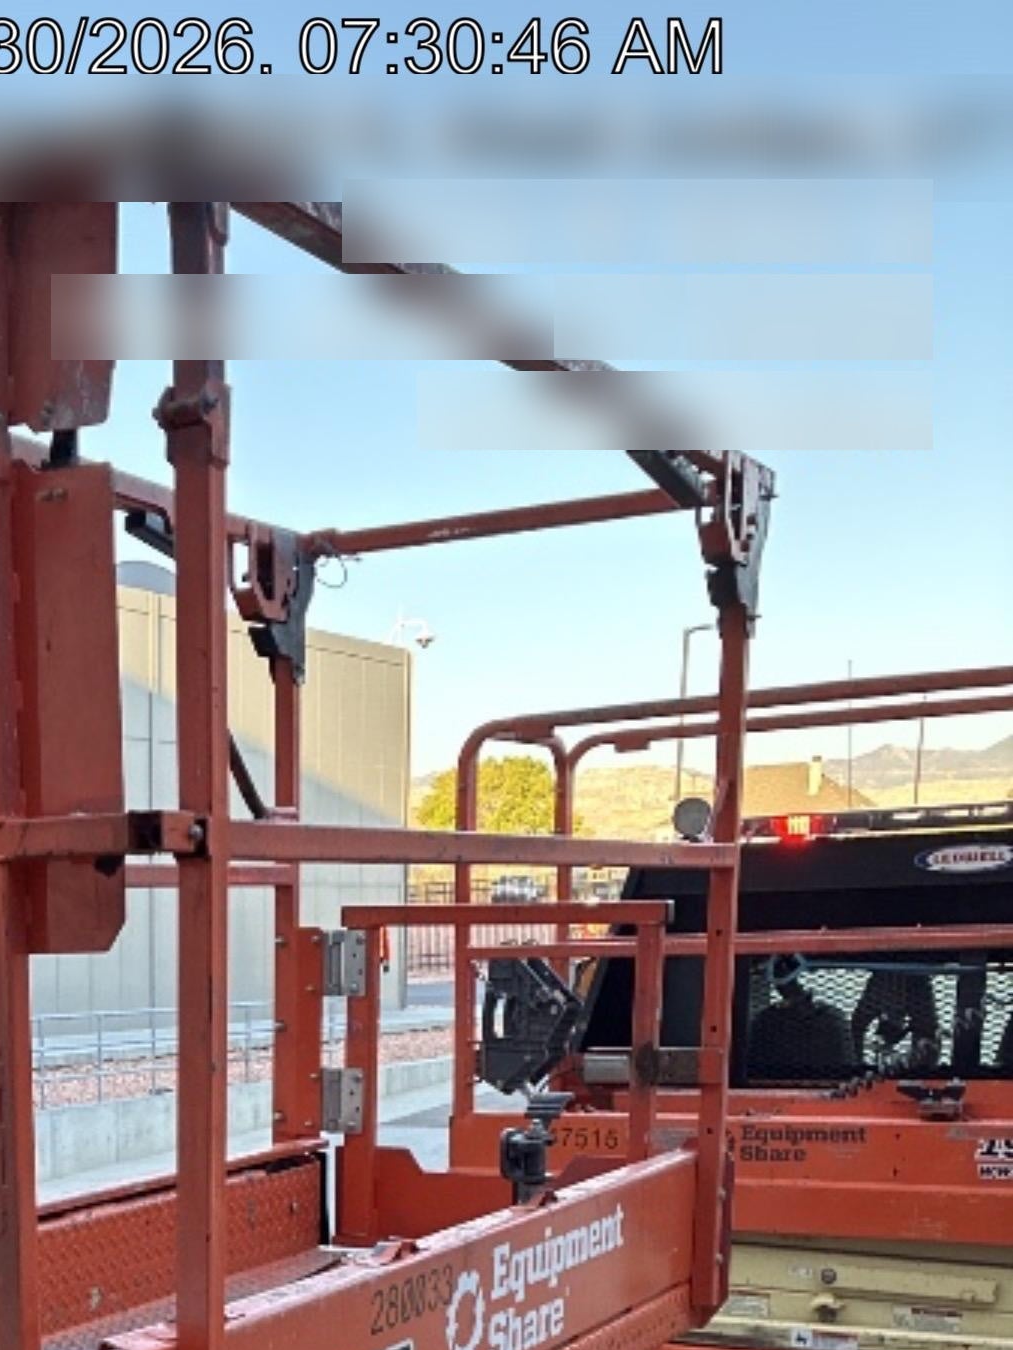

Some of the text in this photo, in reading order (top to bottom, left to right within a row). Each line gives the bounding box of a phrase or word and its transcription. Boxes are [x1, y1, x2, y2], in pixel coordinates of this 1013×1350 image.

[740, 1124, 868, 1146] Equipment
[739, 1145, 807, 1162] Share
[491, 1202, 624, 1303] Equipment
